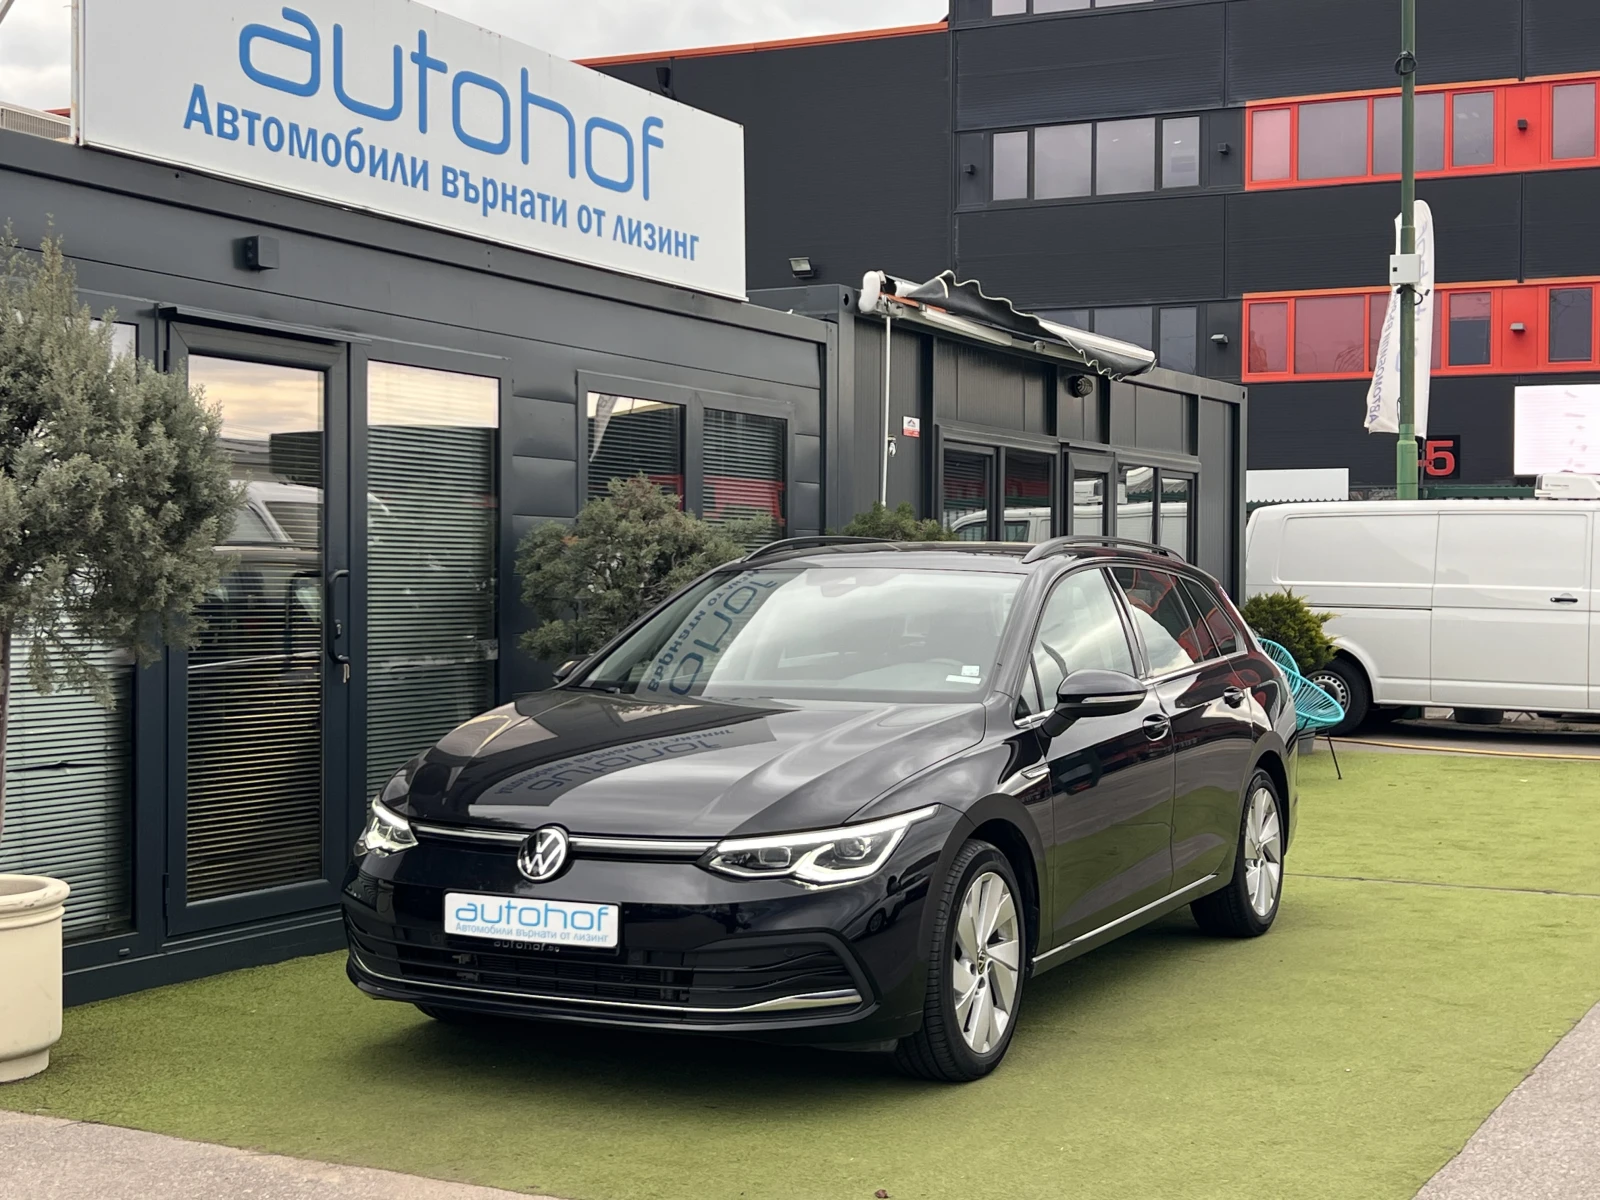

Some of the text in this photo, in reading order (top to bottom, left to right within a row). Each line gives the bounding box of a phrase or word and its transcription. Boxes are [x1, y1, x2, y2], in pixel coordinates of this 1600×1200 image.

[240, 8, 663, 199] autohof
[184, 85, 699, 260] Автомобили върнати от лизинг
[1426, 440, 1456, 476] 5
[455, 900, 609, 932] autohof
[456, 922, 609, 943] Автомобили върнати от лизинг
